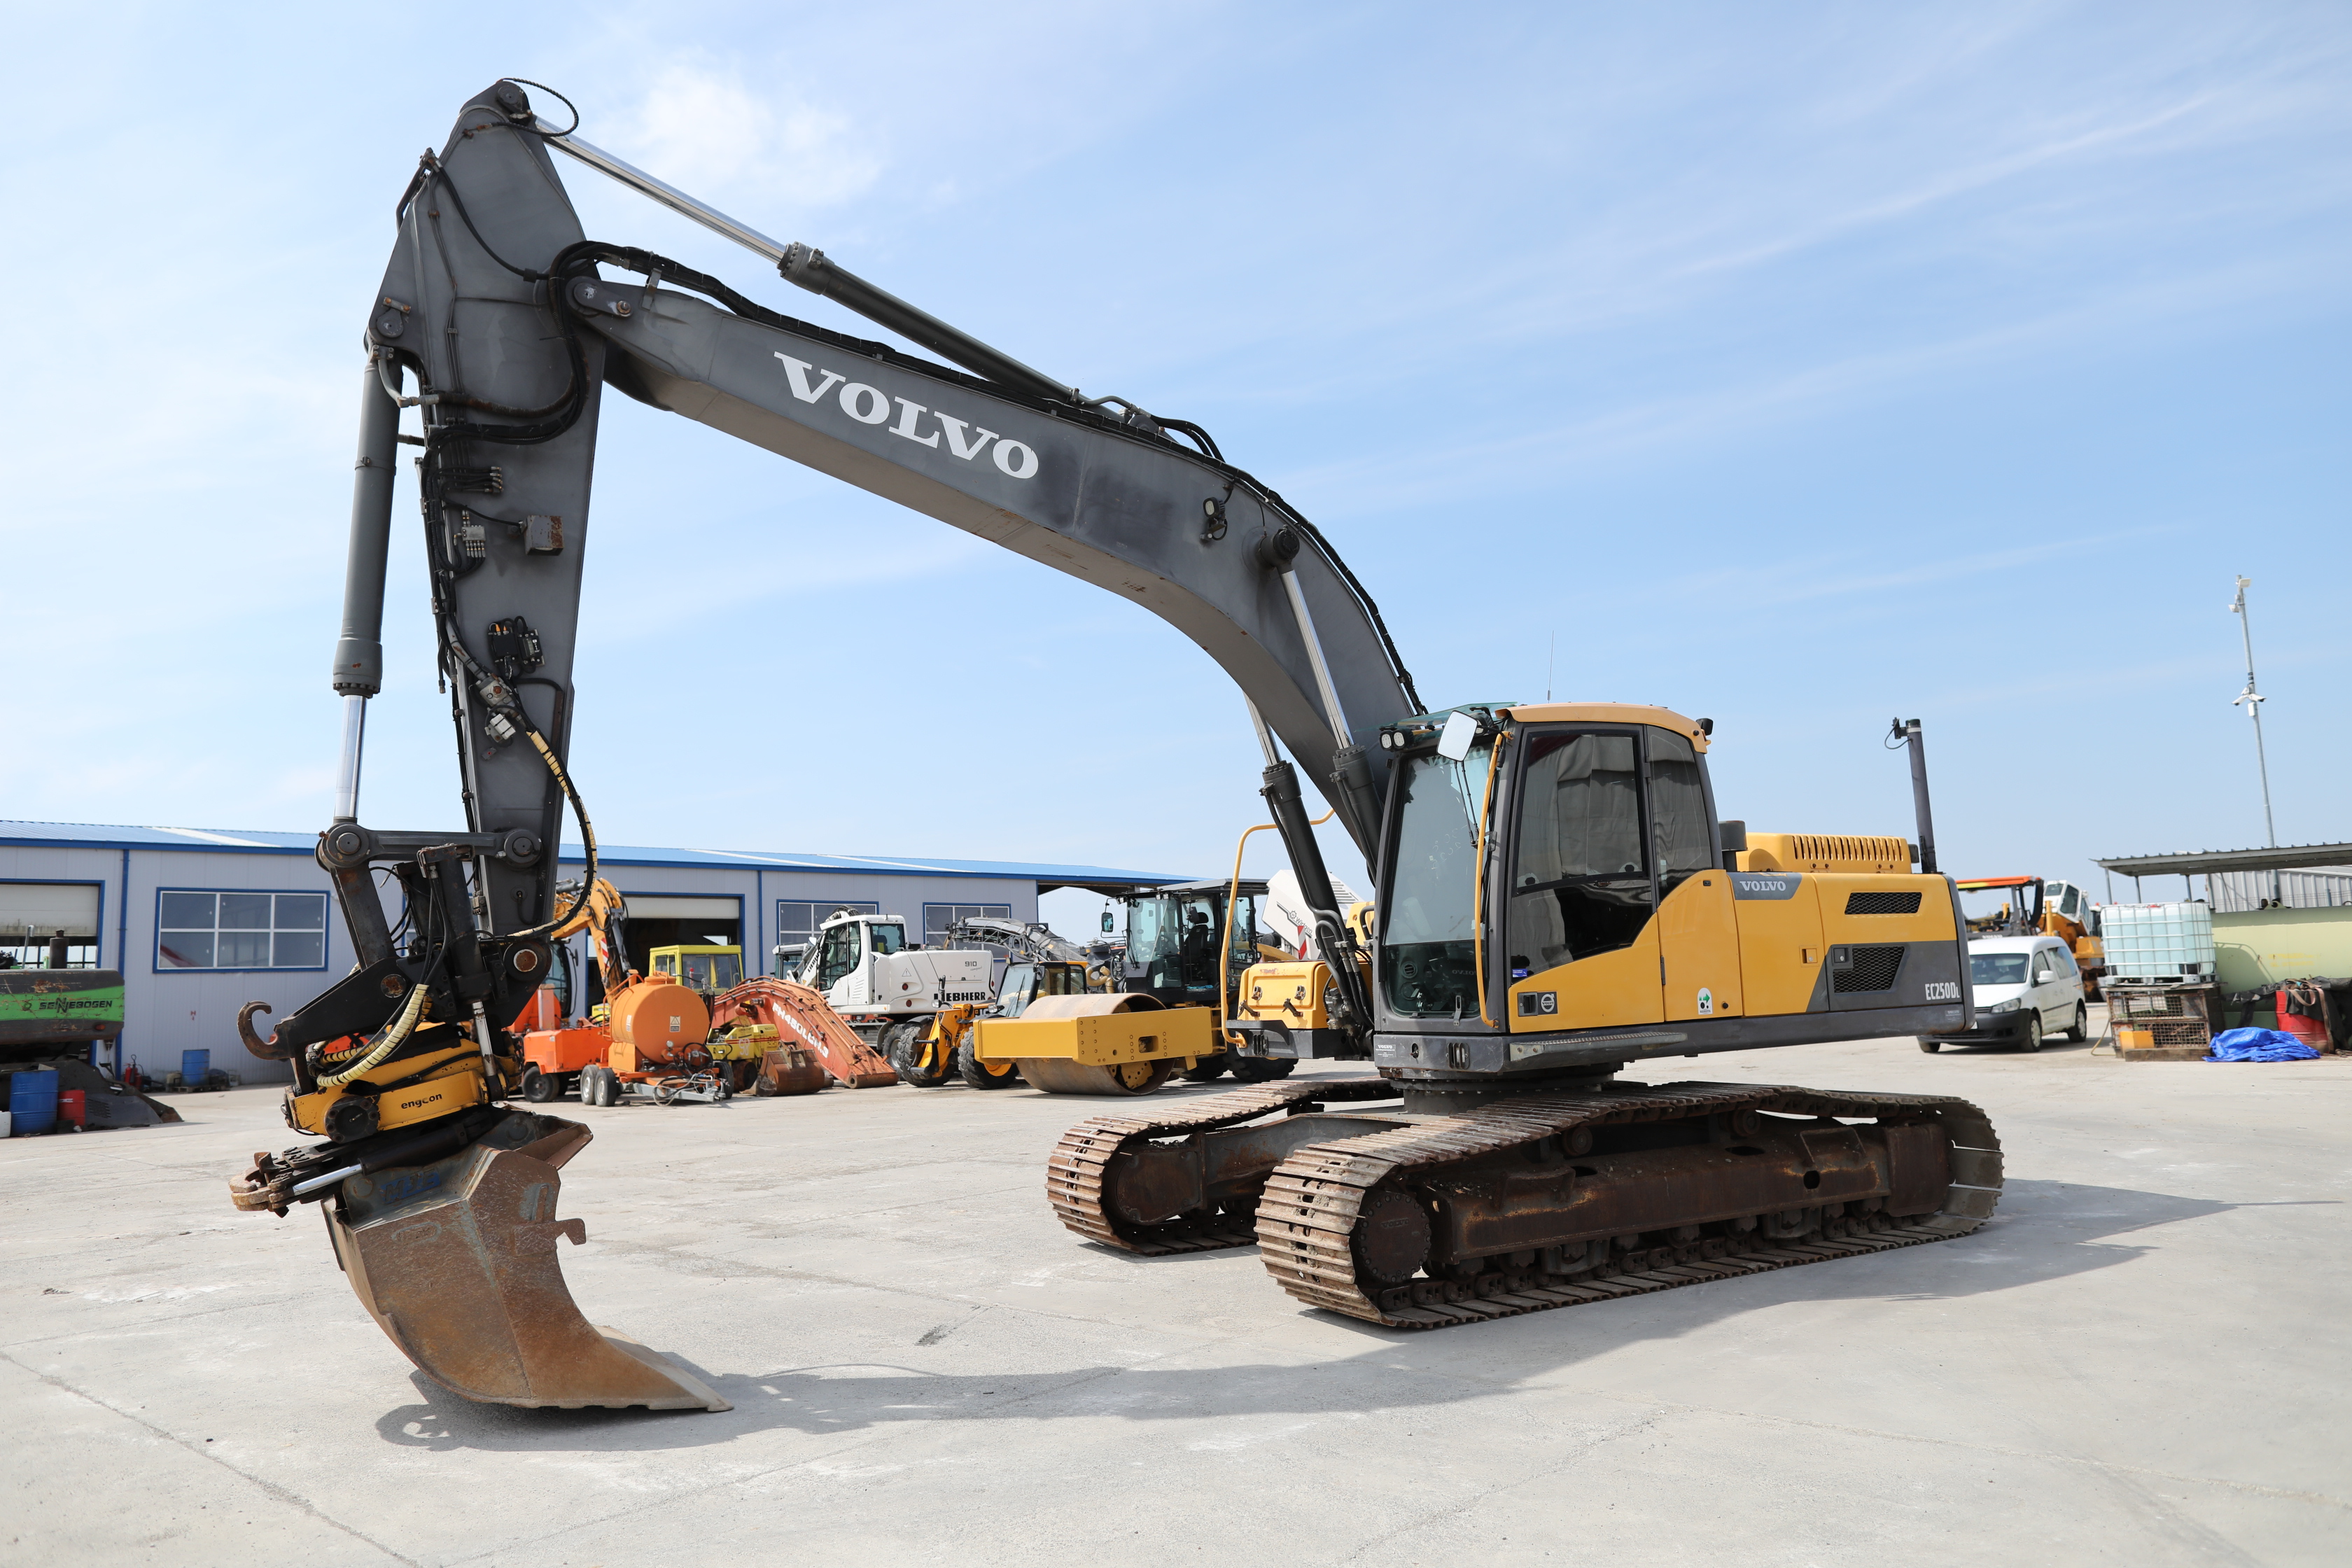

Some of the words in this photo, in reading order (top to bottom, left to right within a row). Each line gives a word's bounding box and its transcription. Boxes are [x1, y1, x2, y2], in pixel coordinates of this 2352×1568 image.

[774, 351, 1039, 479] VOLVO
[1426, 745, 1484, 767] VOO
[1740, 881, 1786, 892] VOLVO
[1296, 916, 1312, 935] Wirtgen
[400, 1093, 442, 1110] engcon
